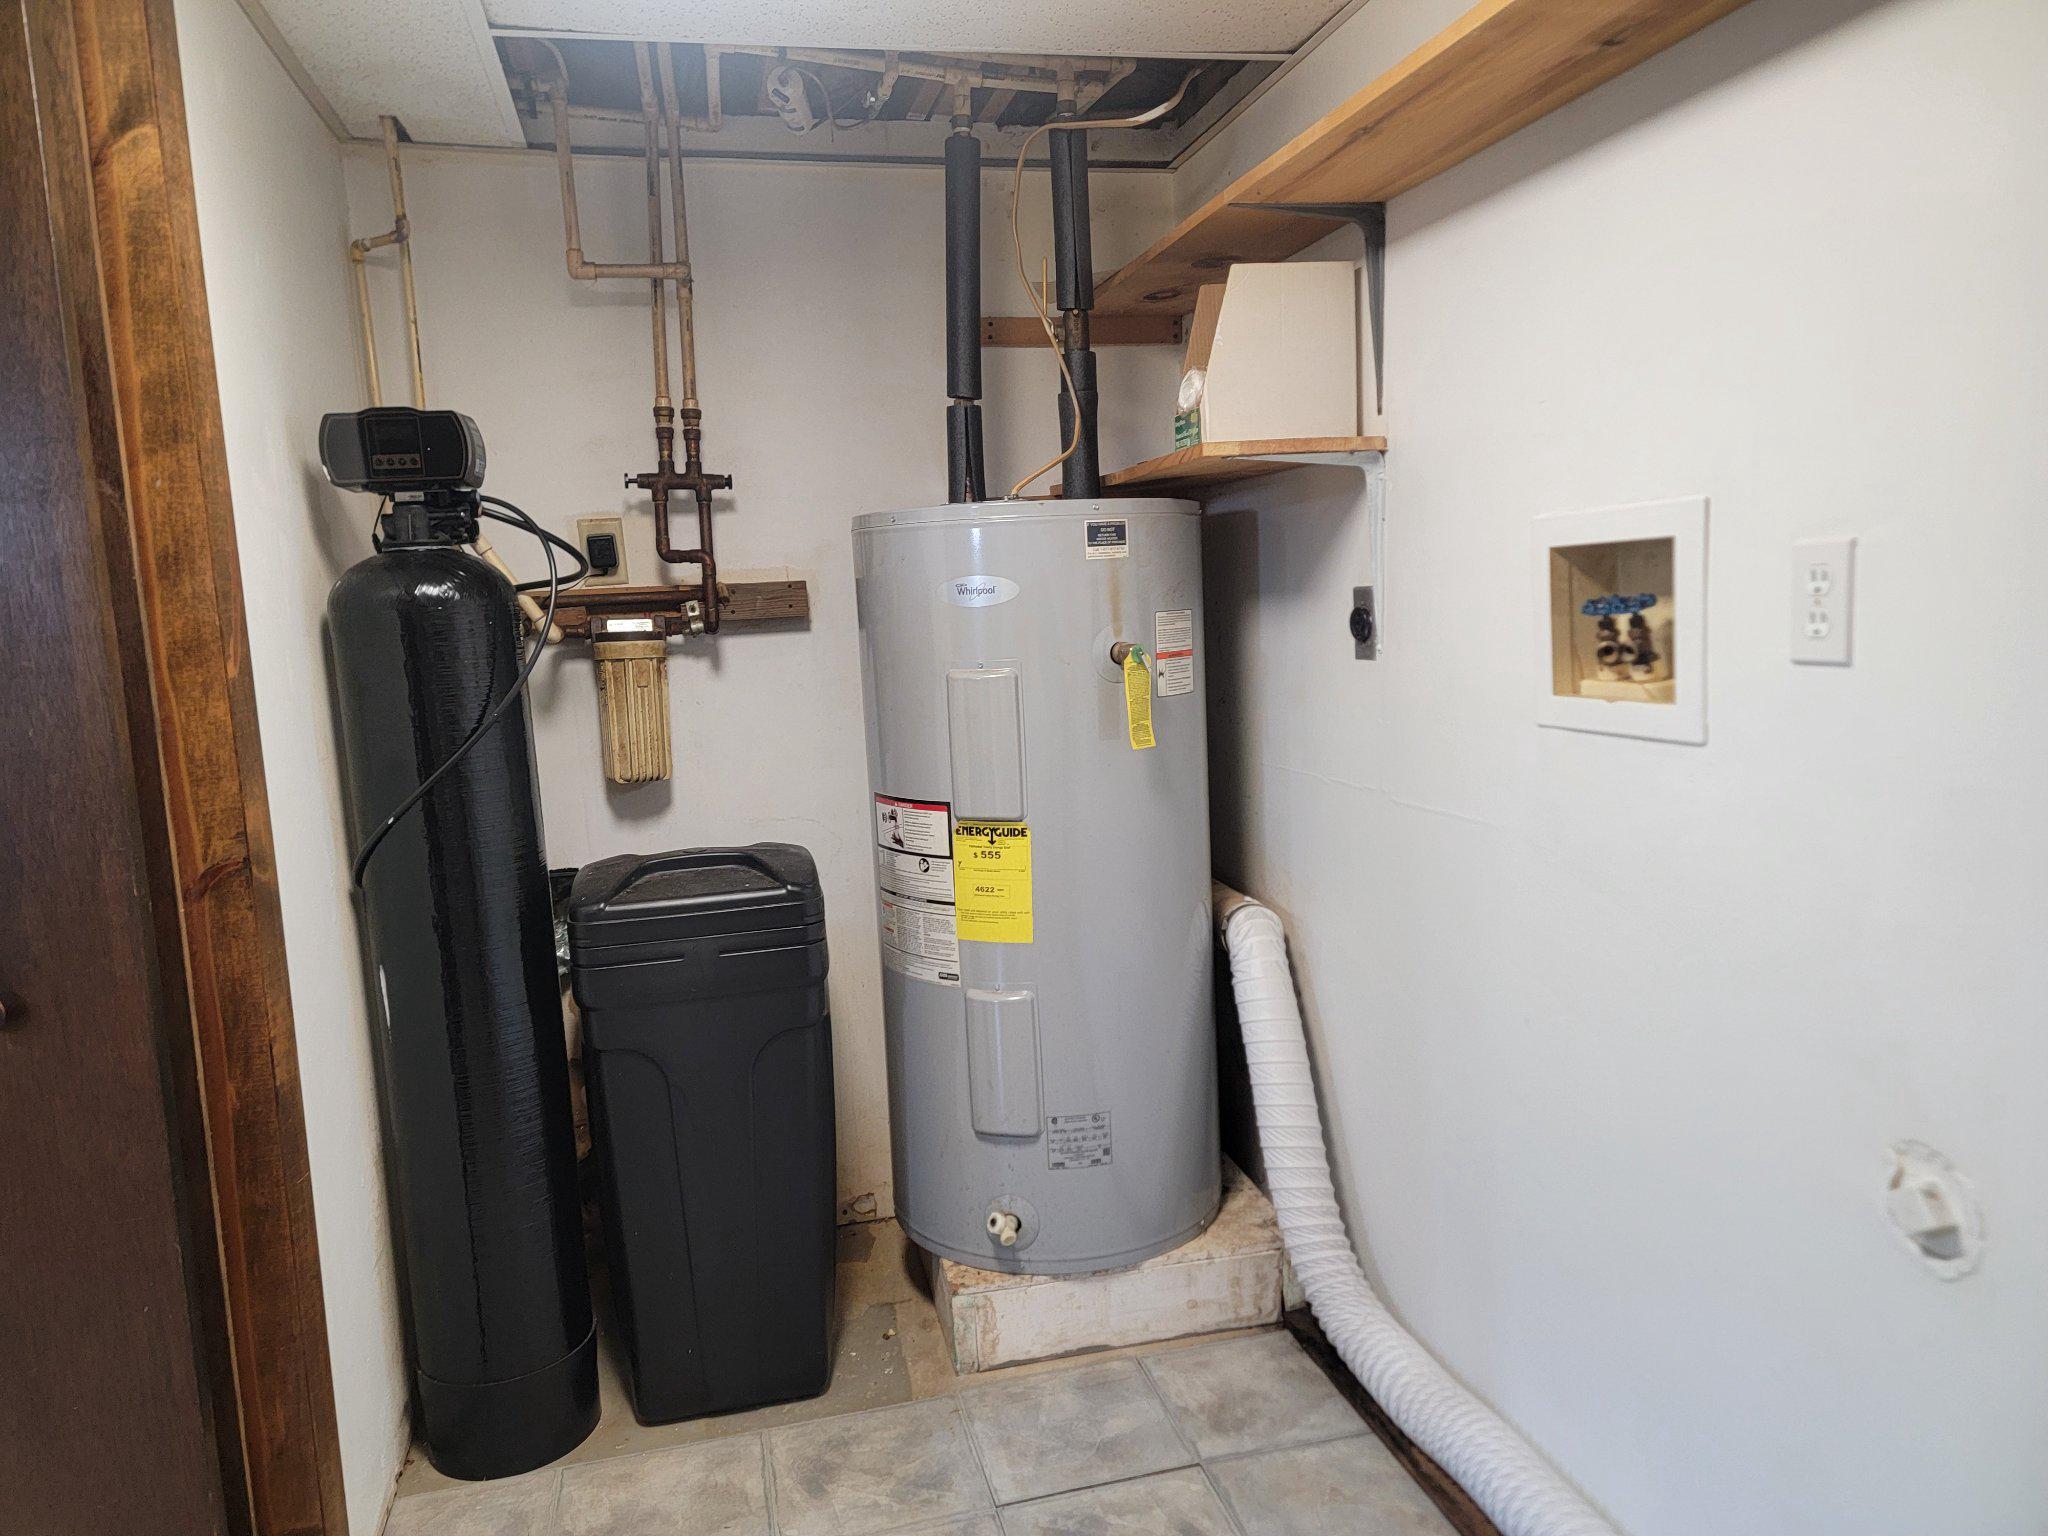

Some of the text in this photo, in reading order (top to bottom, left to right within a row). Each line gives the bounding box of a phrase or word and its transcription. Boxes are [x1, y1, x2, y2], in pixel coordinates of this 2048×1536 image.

[957, 586, 996, 596] Whirlpool
[956, 826, 1028, 838] ENERGYGUIDE
[980, 850, 1002, 860] 555
[975, 885, 995, 893] 4622
